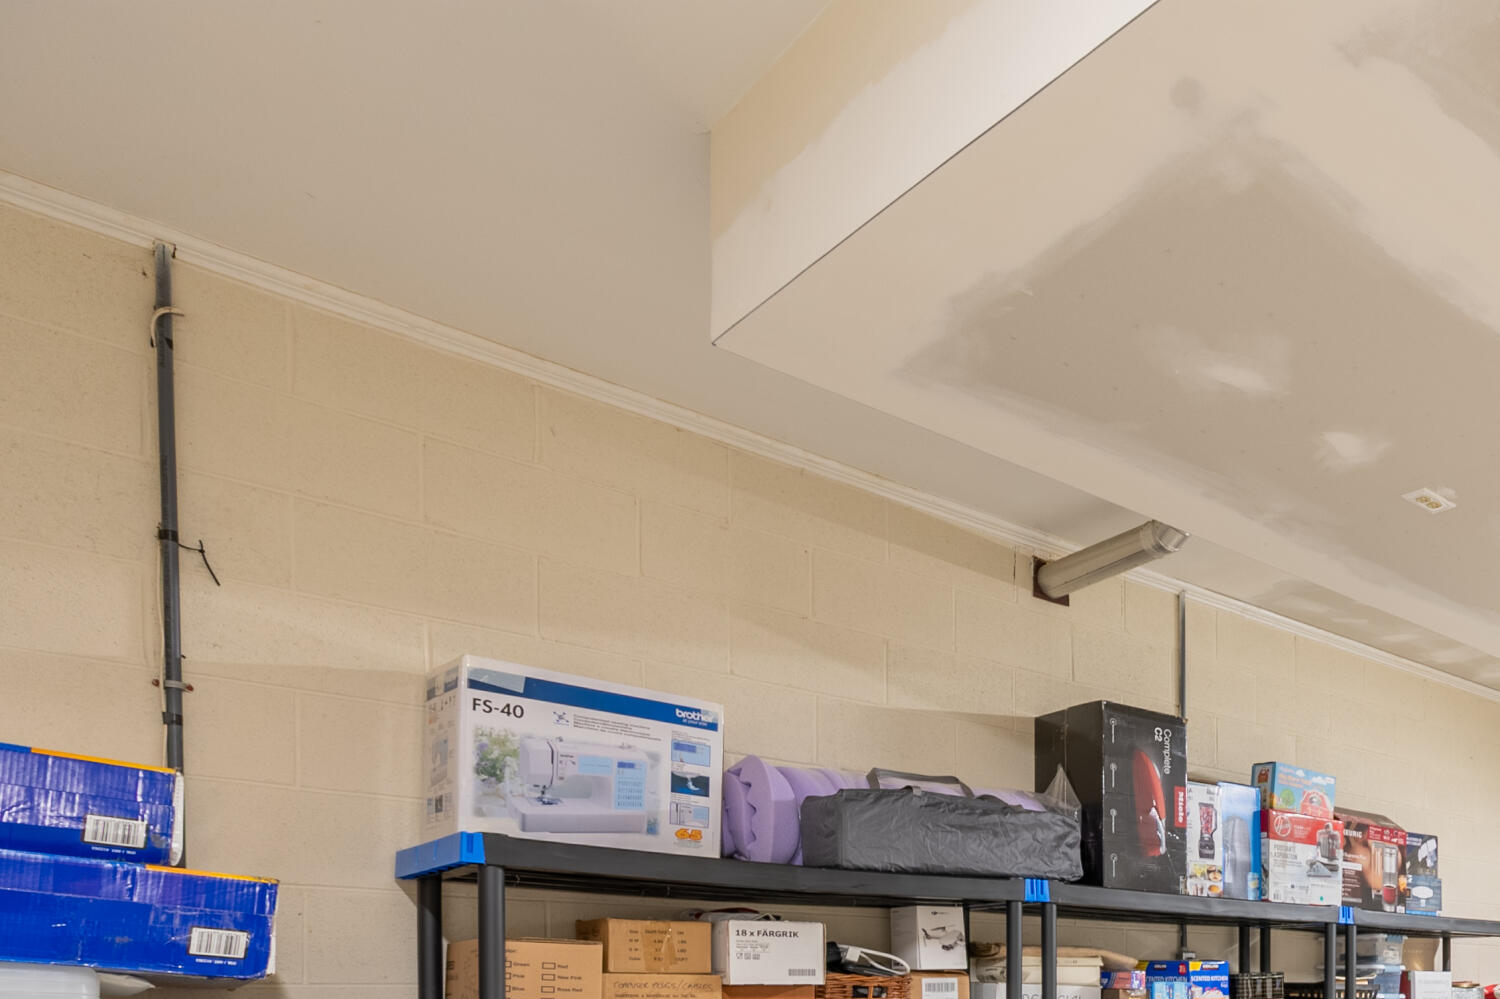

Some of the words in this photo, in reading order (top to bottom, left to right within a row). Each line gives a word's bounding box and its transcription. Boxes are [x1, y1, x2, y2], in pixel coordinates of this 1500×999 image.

[472, 697, 524, 719] FS-40
[1154, 727, 1163, 742] C2
[1163, 728, 1172, 775] Complete
[735, 929, 747, 937] 18
[757, 929, 800, 938] FÄRGRIK
